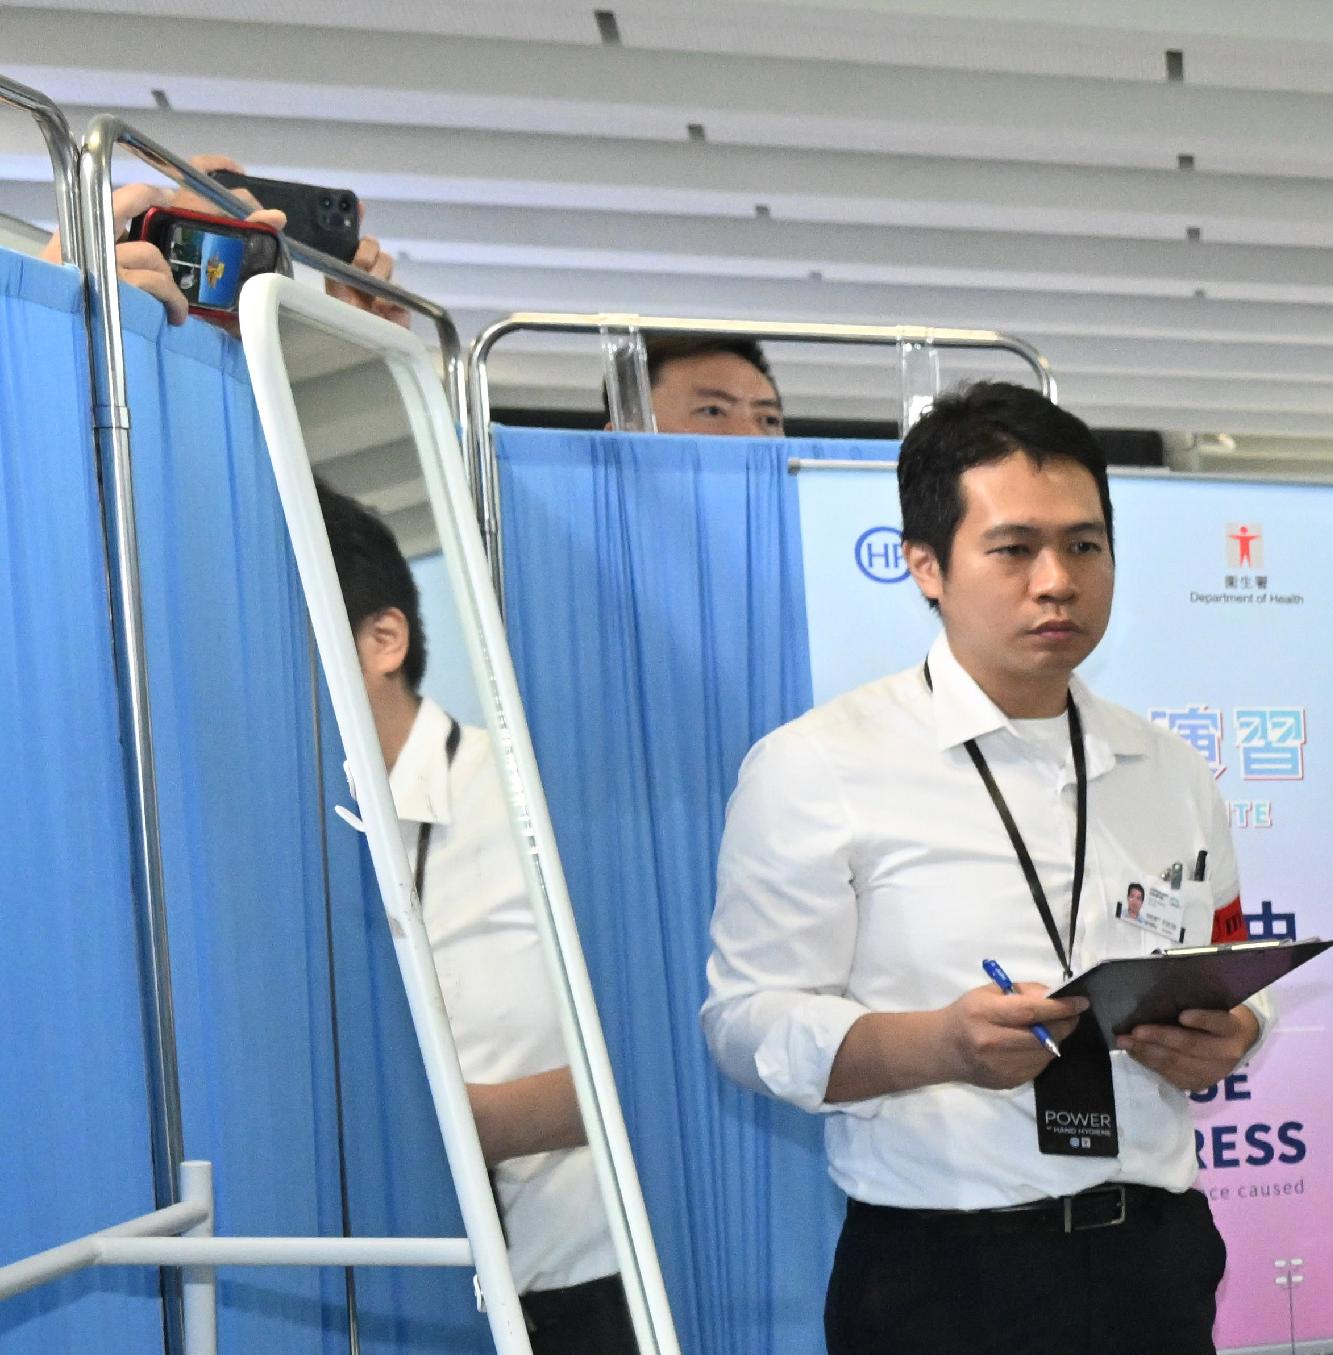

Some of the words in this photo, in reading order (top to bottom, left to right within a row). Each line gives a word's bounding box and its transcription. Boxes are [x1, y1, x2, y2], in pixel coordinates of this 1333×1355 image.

[1190, 591, 1254, 604] Department
[1256, 592, 1267, 603] of
[1269, 594, 1304, 604] Health
[1045, 1110, 1112, 1128] POWER
[1237, 1179, 1305, 1199] caused
